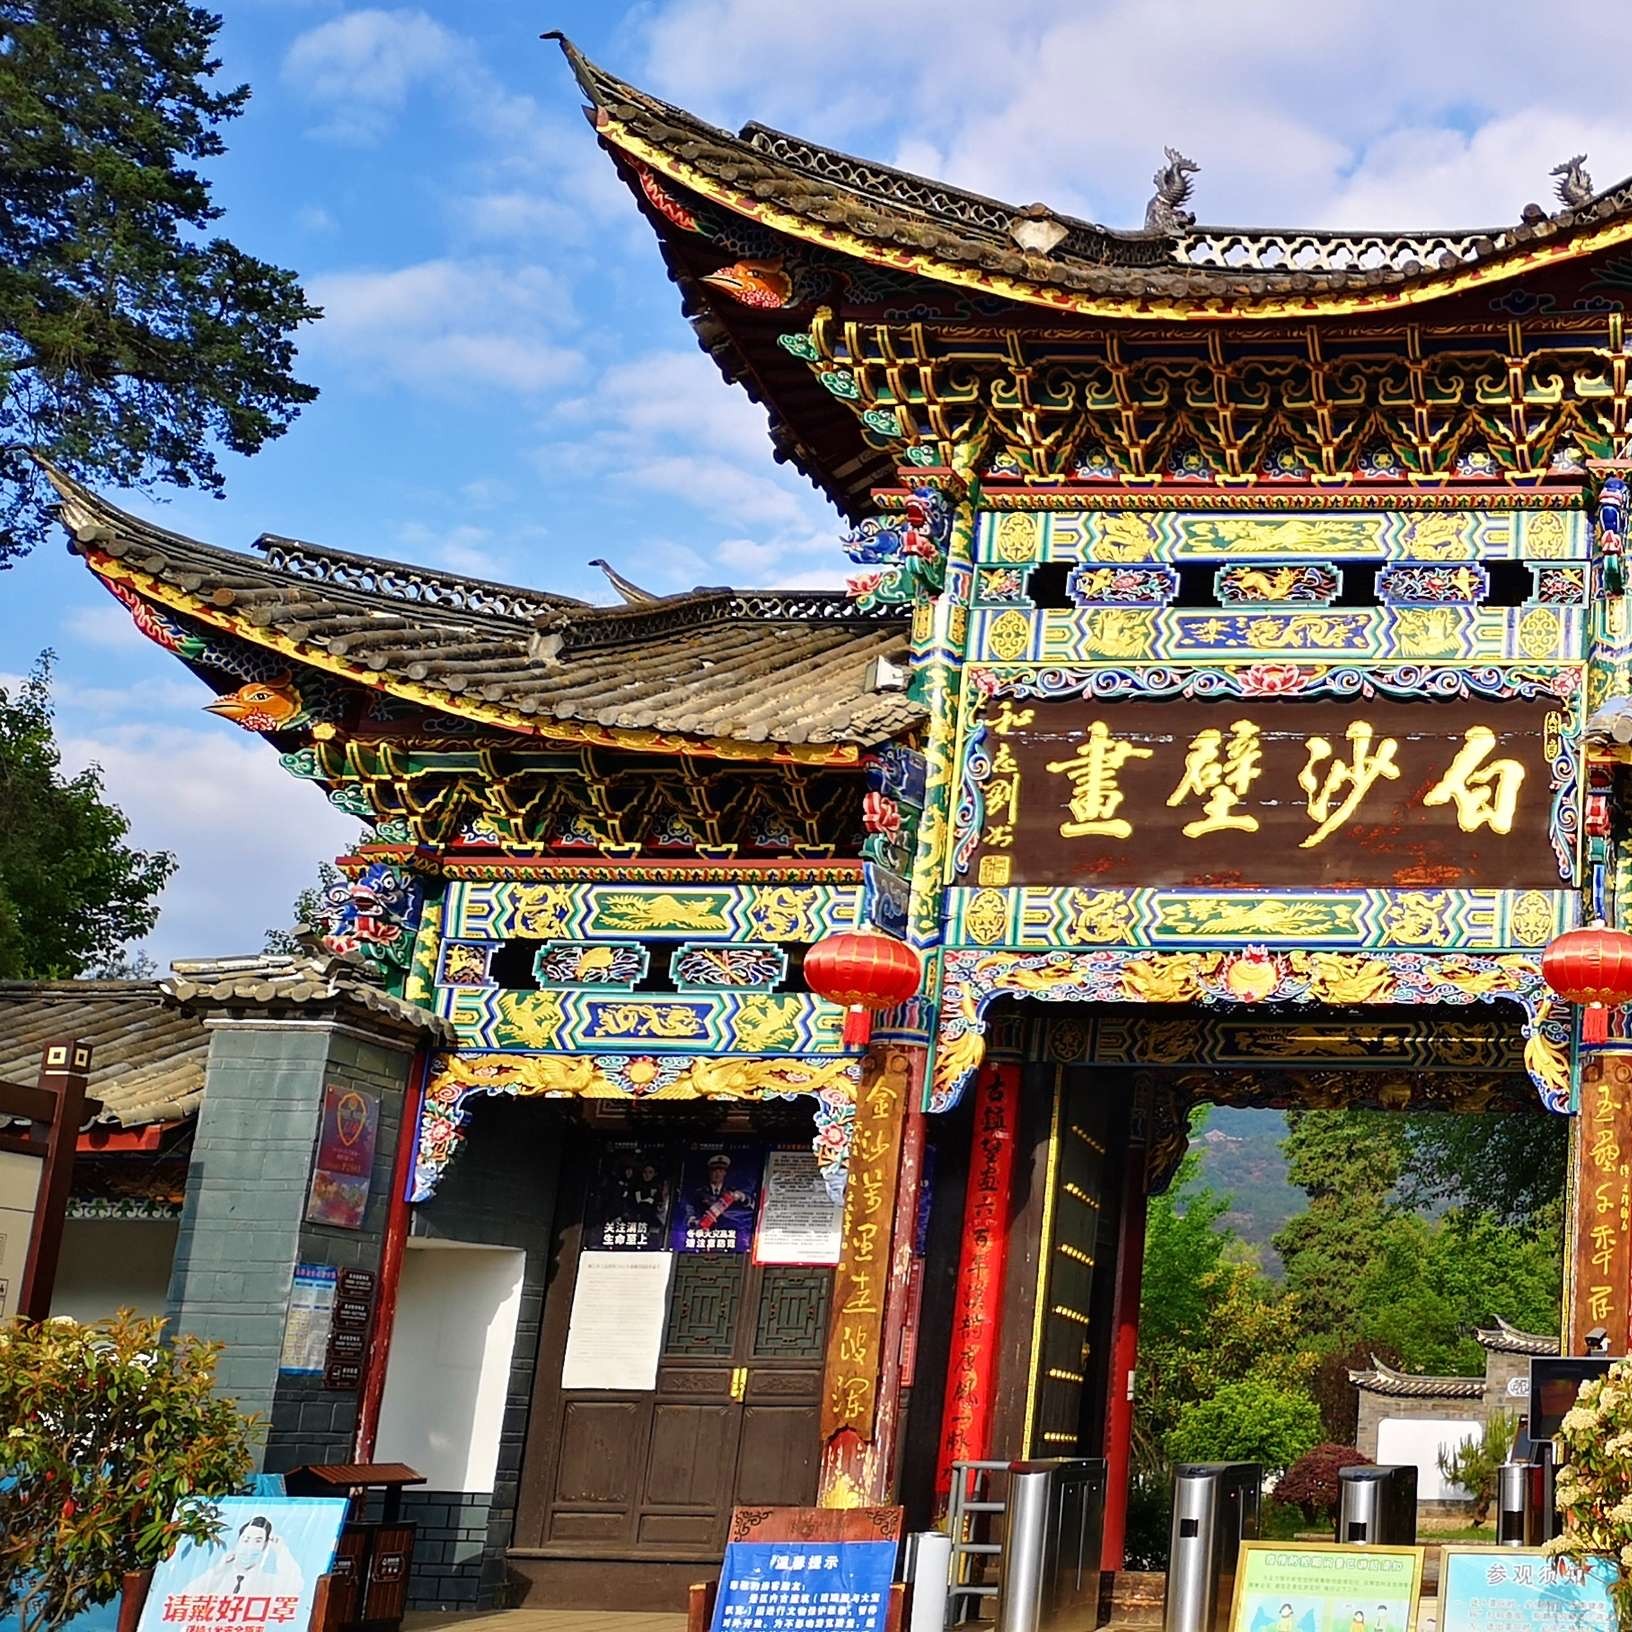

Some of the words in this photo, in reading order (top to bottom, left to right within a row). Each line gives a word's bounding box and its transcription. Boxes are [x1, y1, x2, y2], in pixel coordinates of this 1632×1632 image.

[603, 1222, 648, 1233] 关注消防
[603, 1233, 648, 1245] 生命至上
[1487, 1564, 1587, 1587] 参观须知
[162, 1596, 299, 1623] 请戴好口罩
